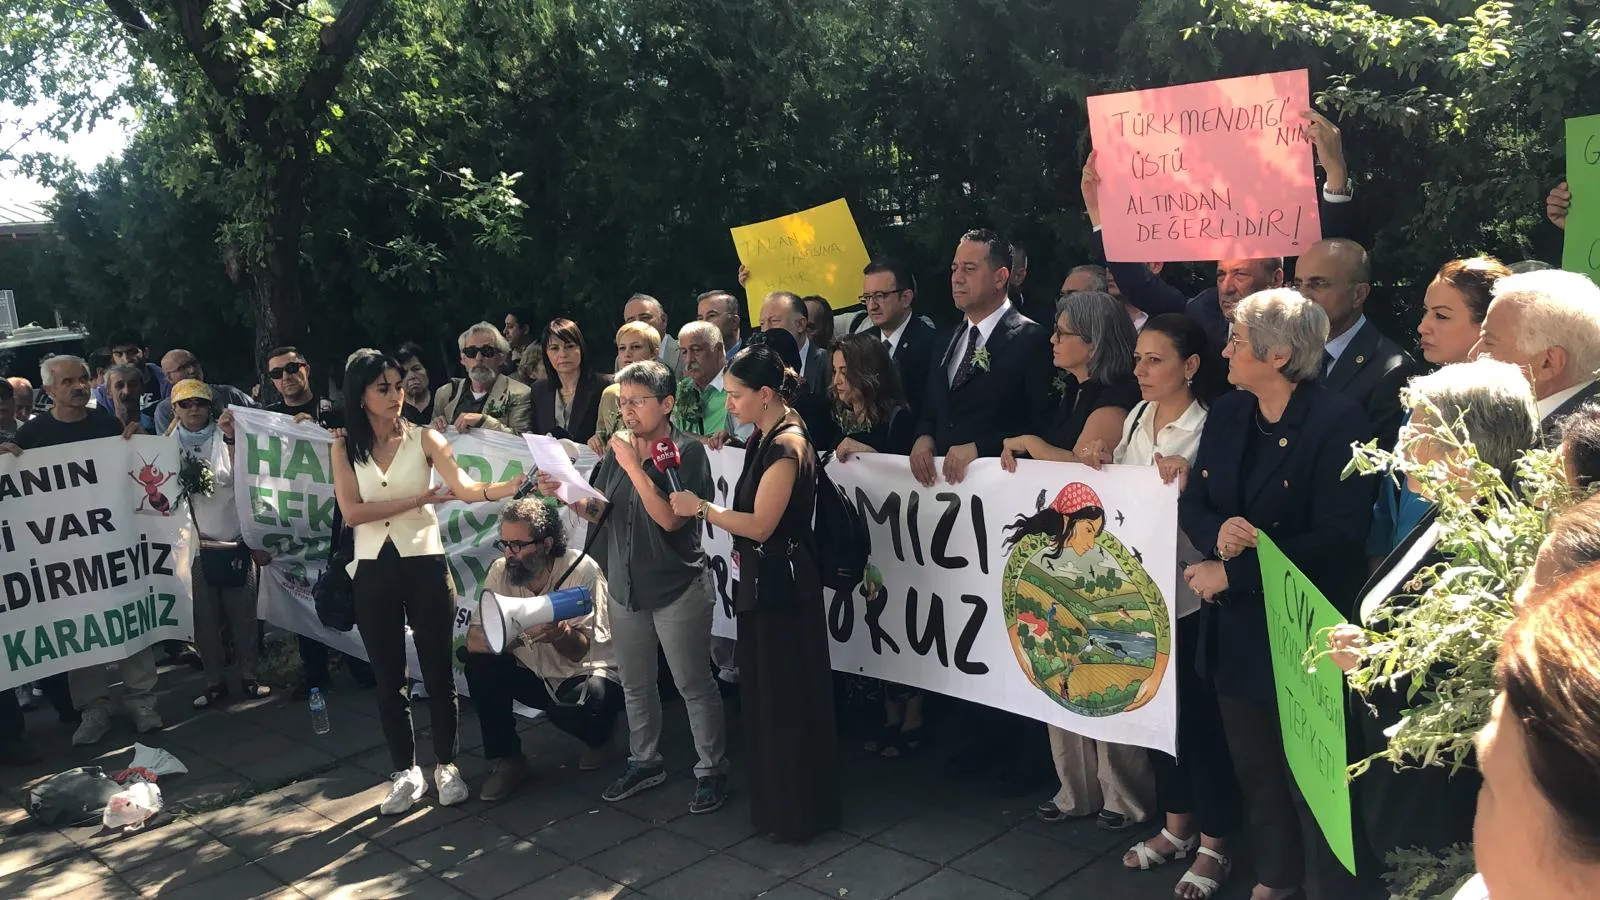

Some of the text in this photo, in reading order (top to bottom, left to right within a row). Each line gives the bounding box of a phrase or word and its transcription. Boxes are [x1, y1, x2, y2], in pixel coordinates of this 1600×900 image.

[1131, 148, 1187, 180] ÜSTÜ
[1126, 188, 1232, 215] ALTINDAN
[742, 232, 800, 257] TALAN
[26, 508, 117, 545] VAR
[838, 484, 989, 575] MIZI
[0, 534, 174, 612] DİRMEYİZ
[5, 586, 179, 672] KARADENİZ
[1284, 570, 1316, 658] CVK
